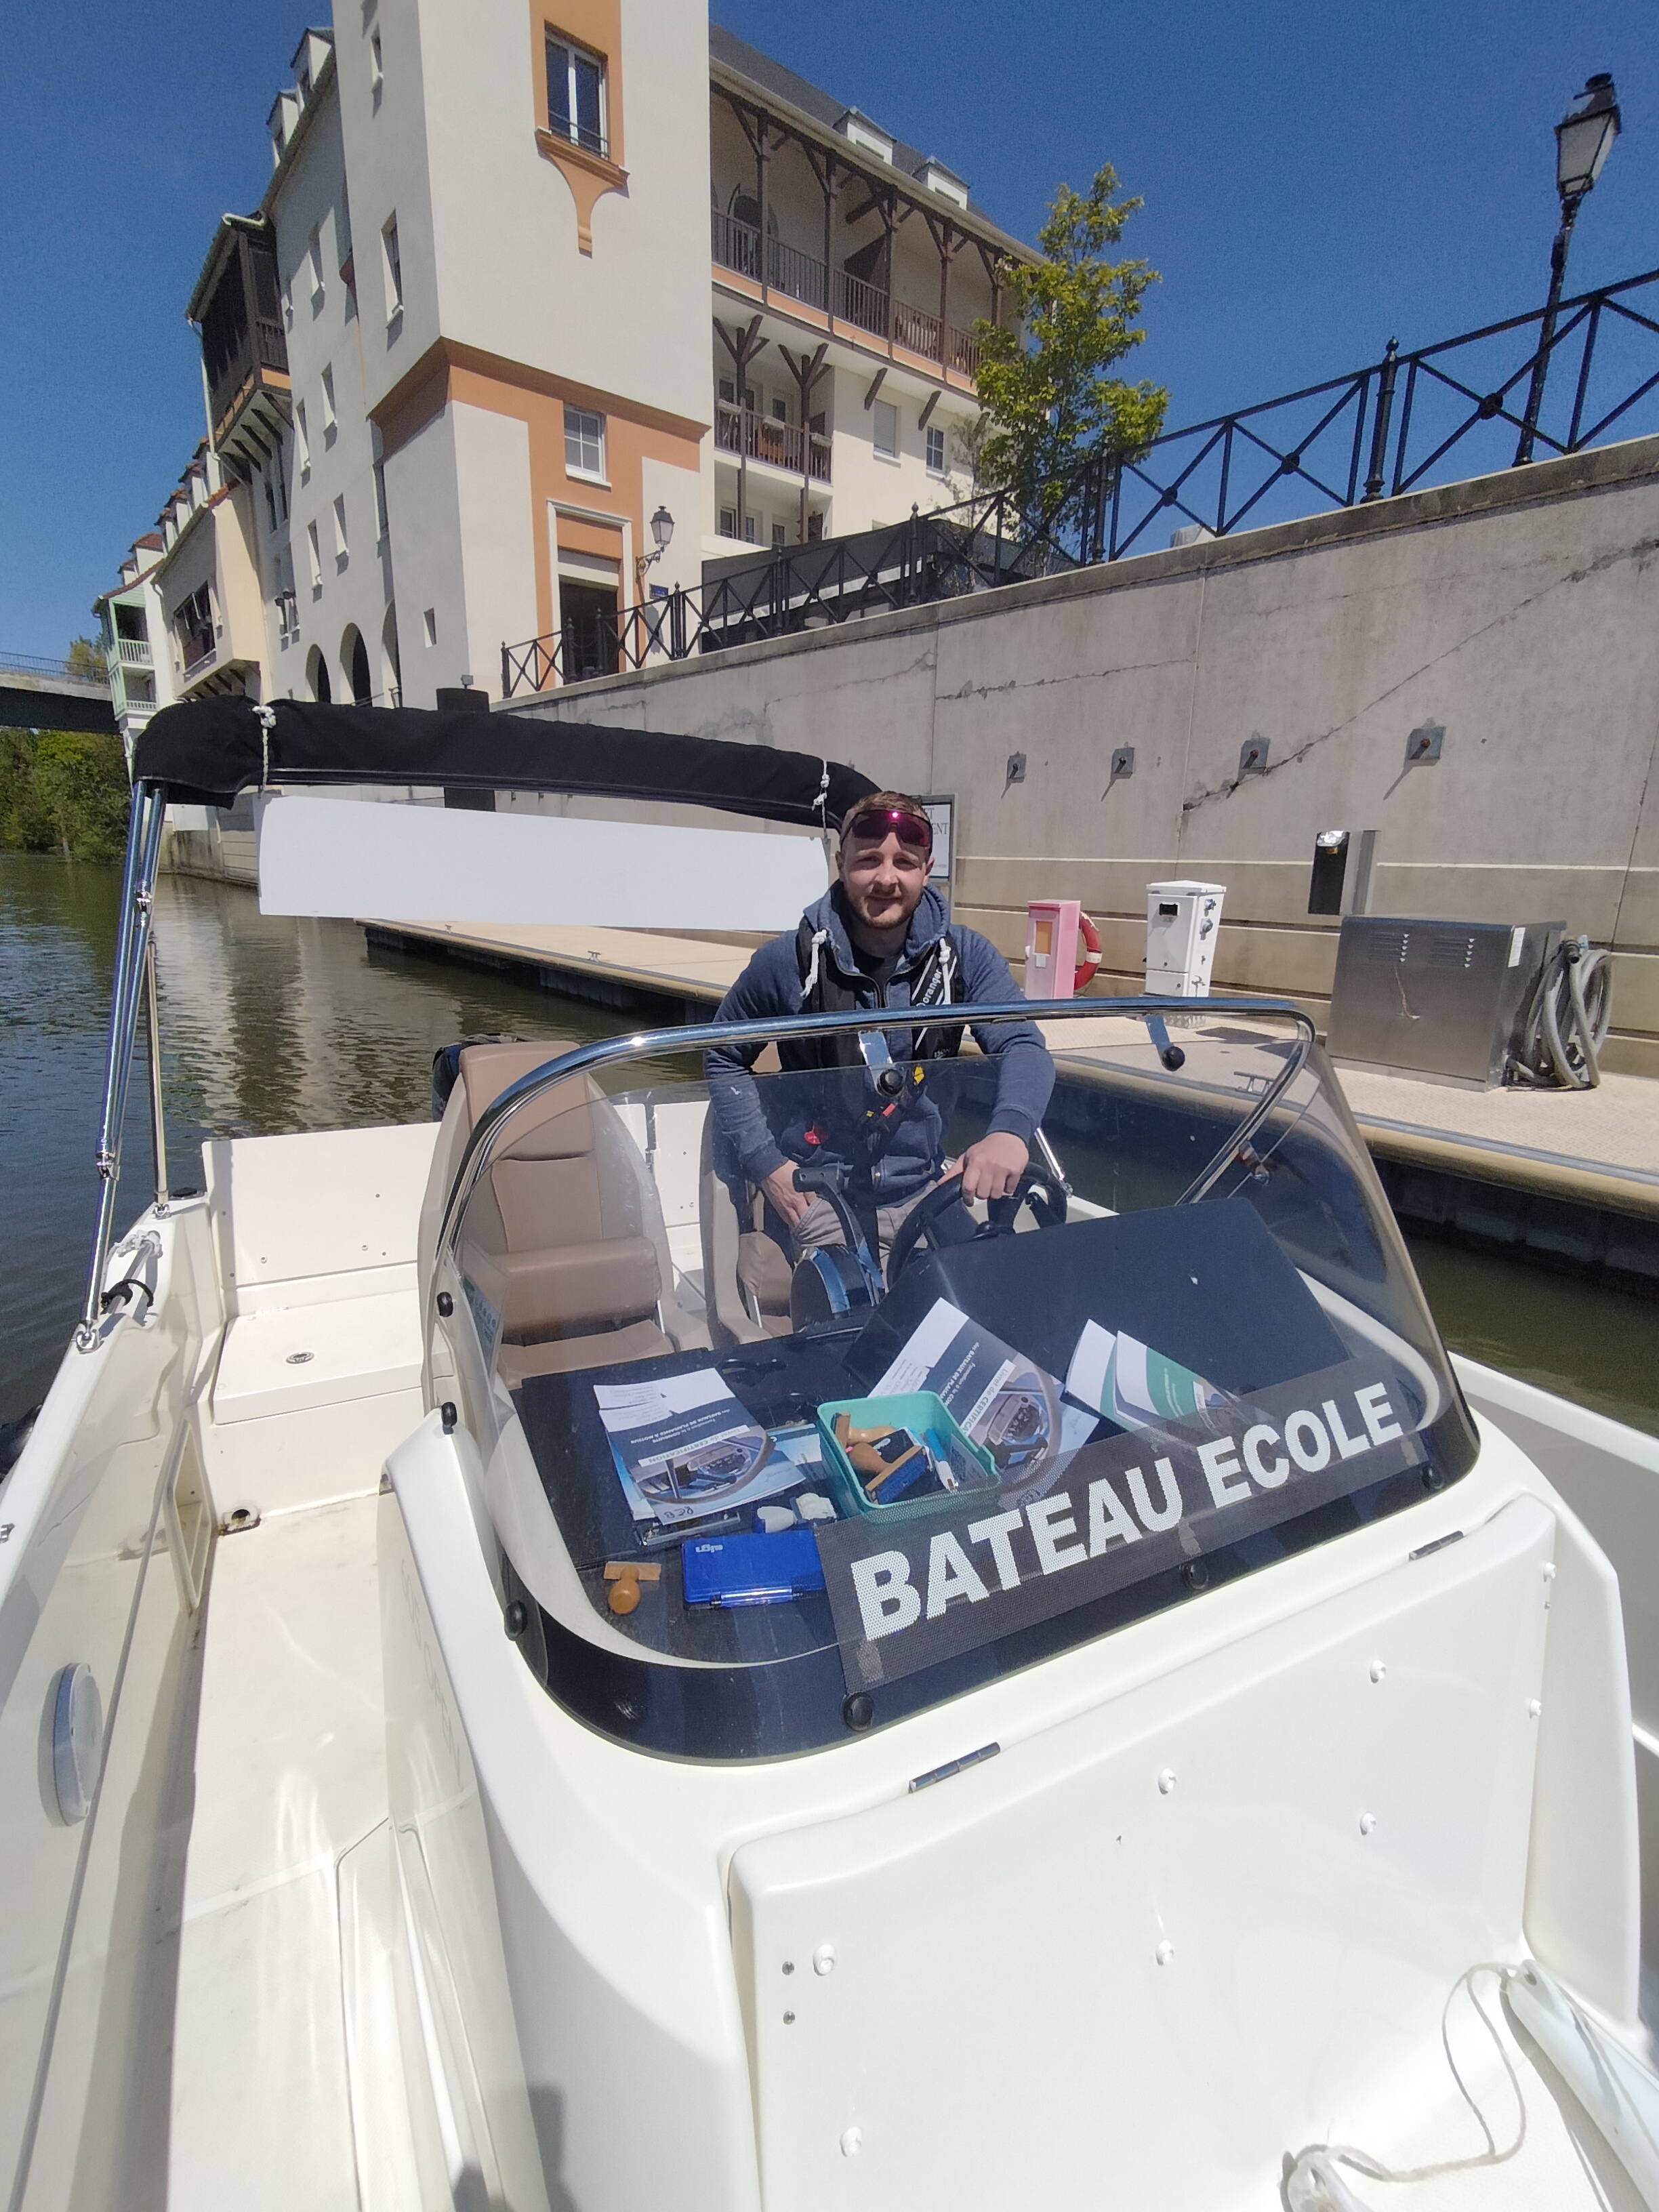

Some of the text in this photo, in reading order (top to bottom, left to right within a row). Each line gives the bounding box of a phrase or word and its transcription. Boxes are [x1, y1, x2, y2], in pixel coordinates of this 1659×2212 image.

[956, 1349, 975, 1373] BATEAUX
[992, 1368, 1008, 1387] Livret
[985, 1385, 996, 1396] de
[648, 1439, 708, 1464] CERTIFICATION
[851, 1382, 1404, 1641] BATEAU ECOLE
[424, 1641, 461, 1788] OPEN
